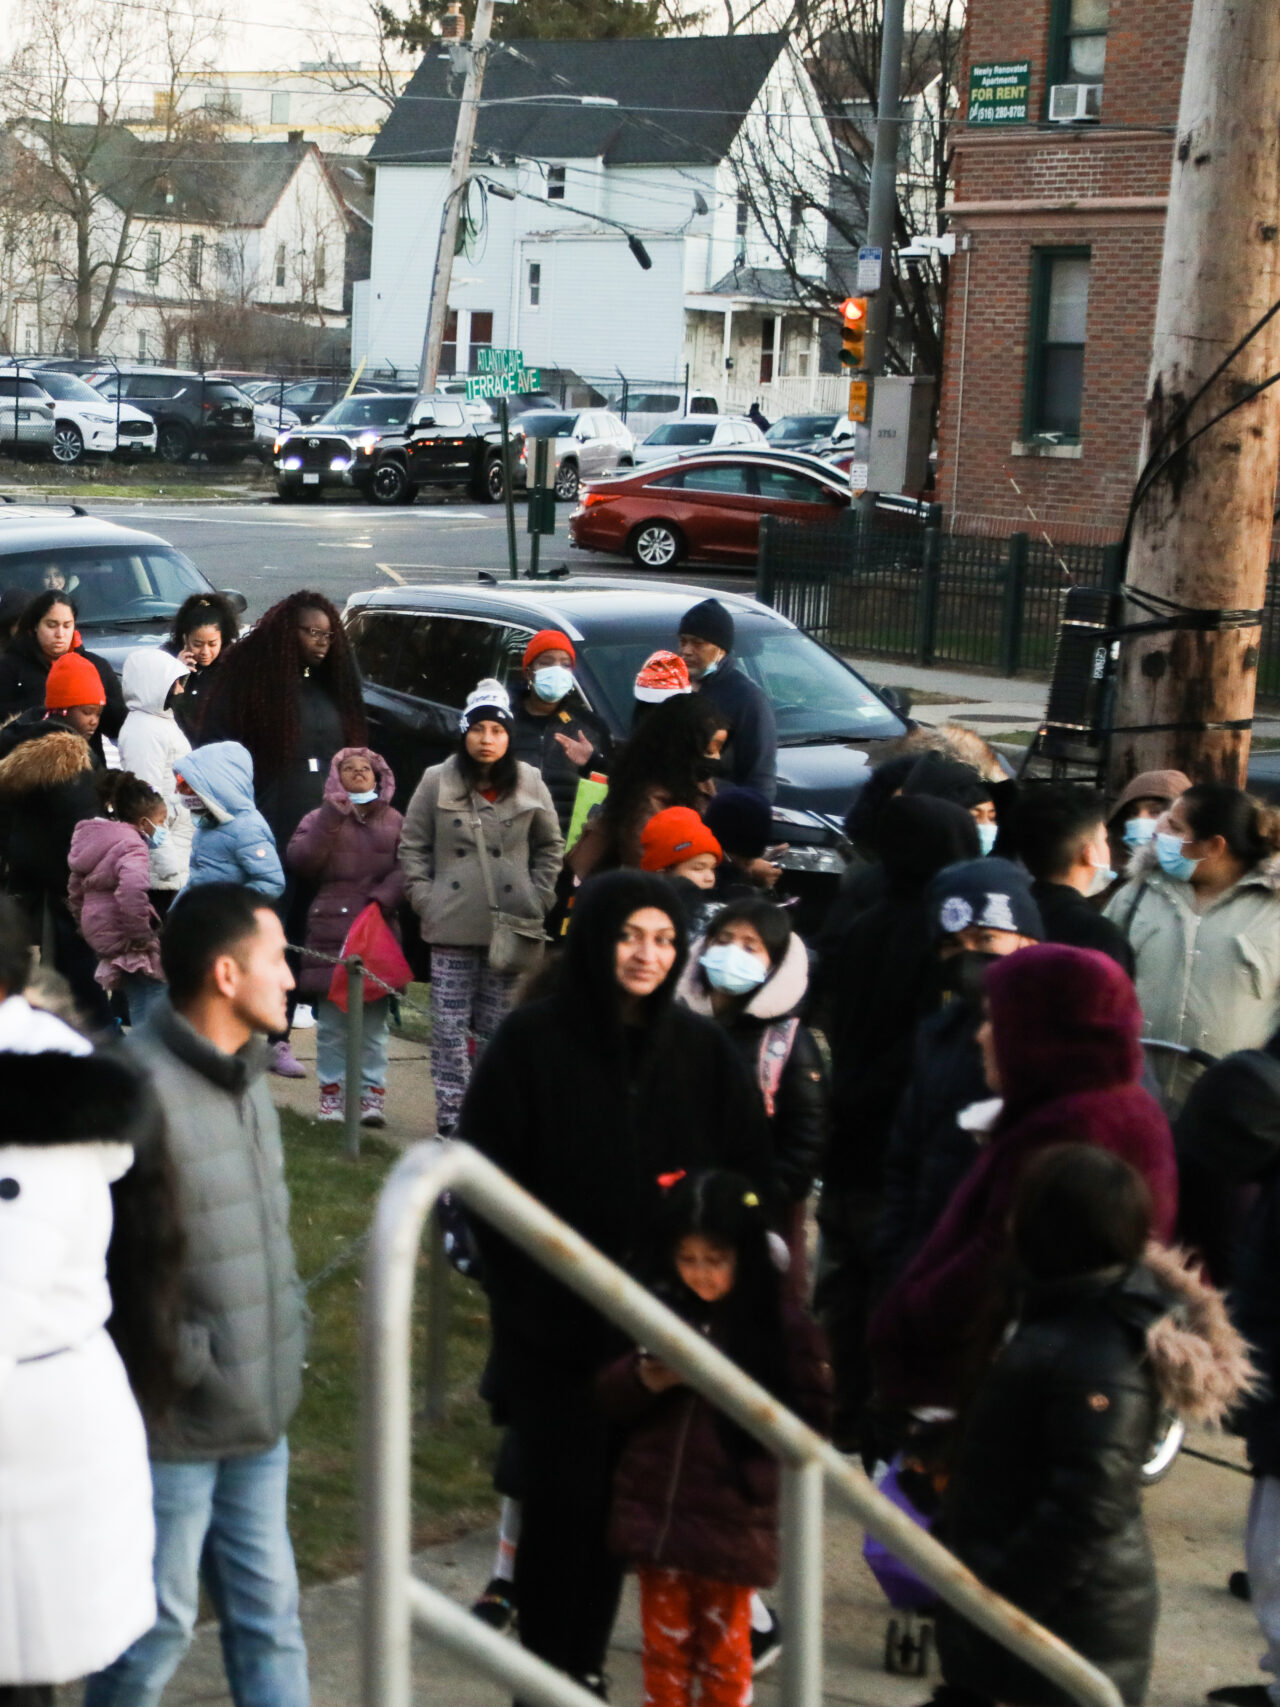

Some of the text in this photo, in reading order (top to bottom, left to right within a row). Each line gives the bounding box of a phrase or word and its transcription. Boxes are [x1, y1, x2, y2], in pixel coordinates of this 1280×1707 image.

[974, 64, 1028, 76] Newly Renovated
[981, 76, 1018, 86] Apartments
[971, 85, 1027, 101] FOR RENT
[978, 107, 994, 122] (516)
[477, 349, 508, 373] ATLANTIC
[465, 372, 516, 400] TERRACE
